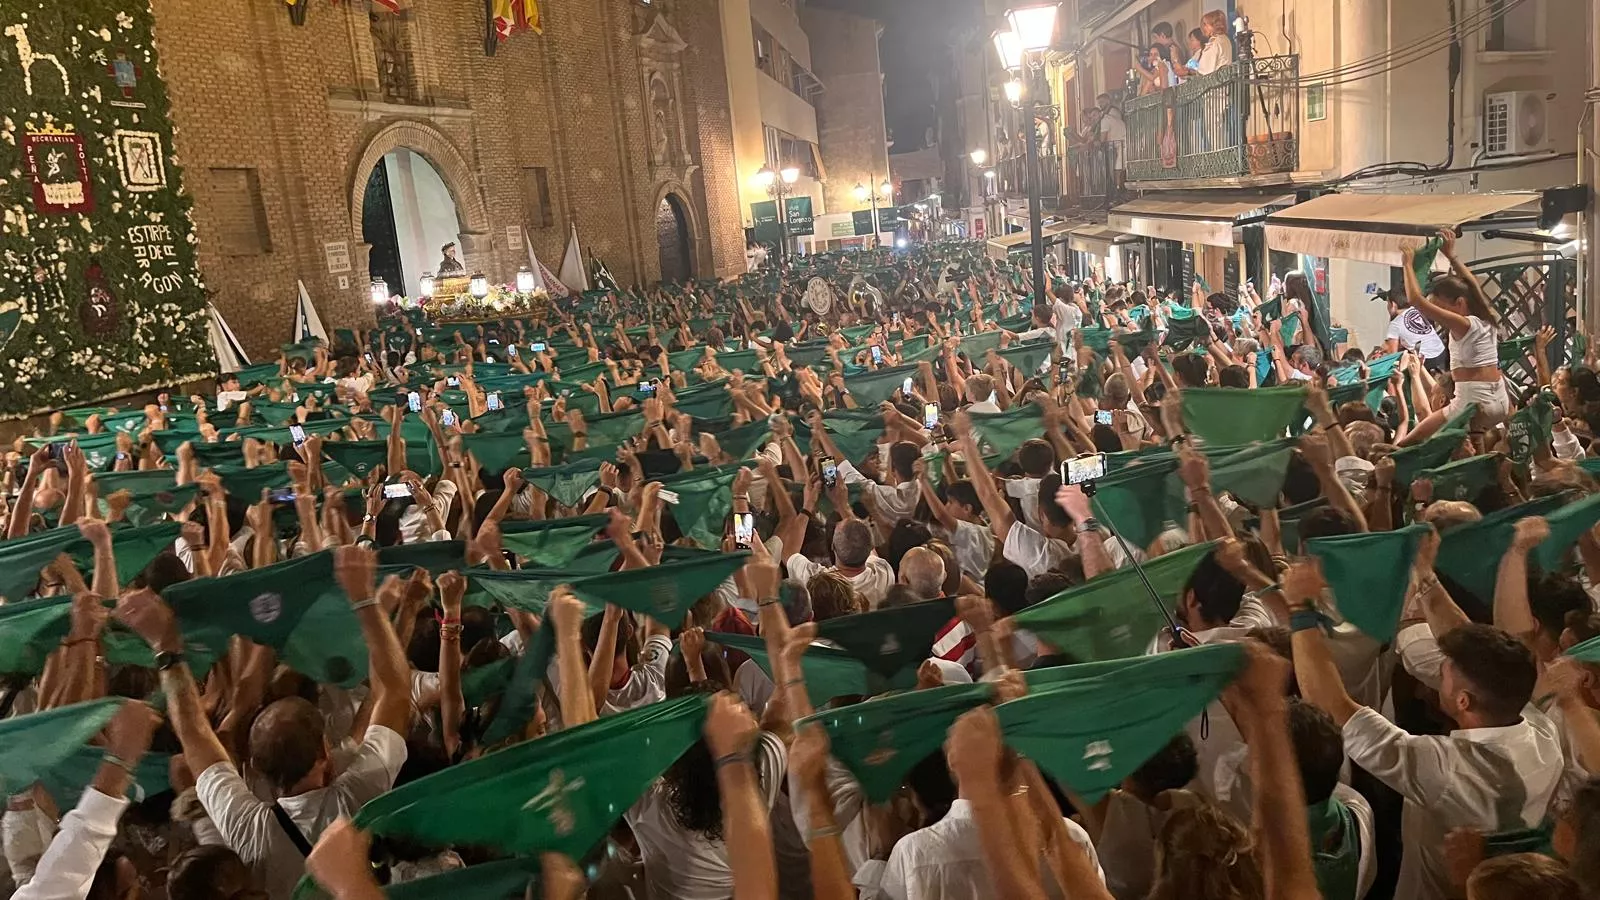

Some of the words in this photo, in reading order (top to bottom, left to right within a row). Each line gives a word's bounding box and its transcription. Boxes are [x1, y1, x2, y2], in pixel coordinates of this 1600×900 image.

[789, 216, 812, 224] Lorenzo
[127, 225, 172, 243] ESTIRPE
[148, 245, 163, 259] DE
